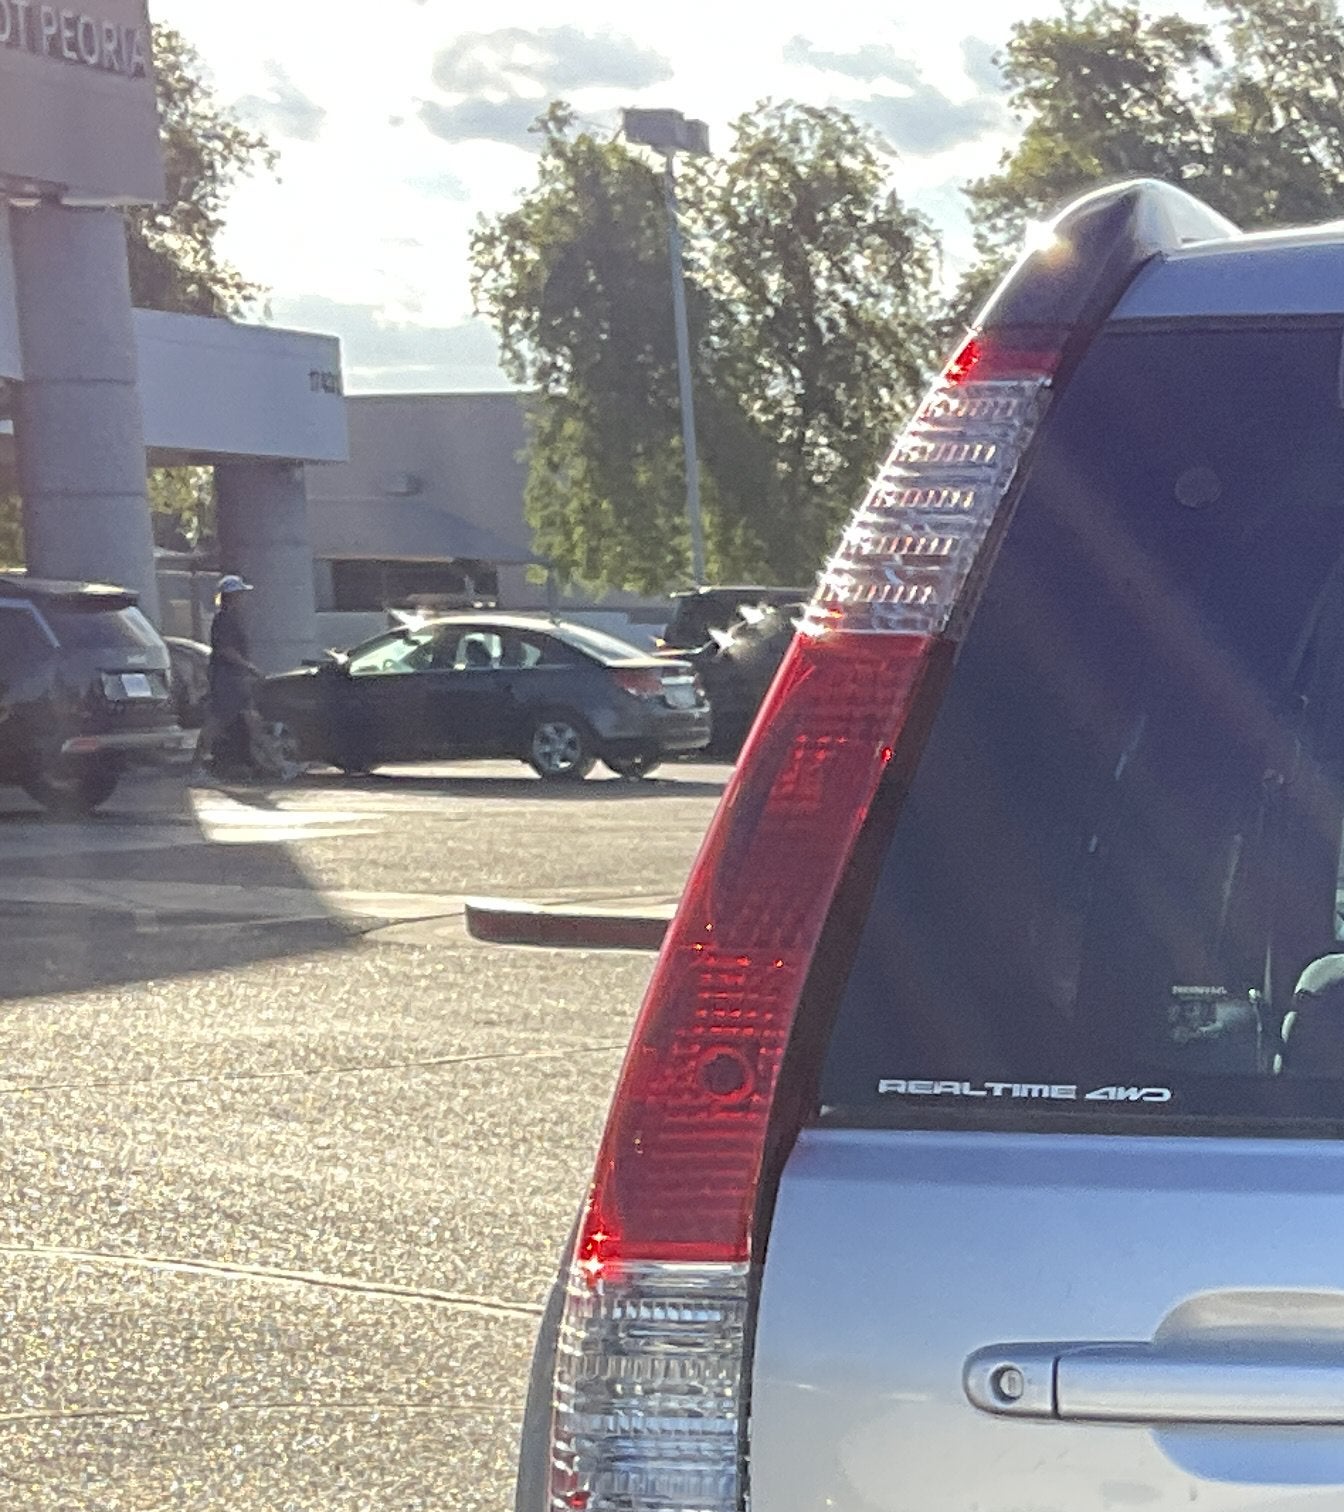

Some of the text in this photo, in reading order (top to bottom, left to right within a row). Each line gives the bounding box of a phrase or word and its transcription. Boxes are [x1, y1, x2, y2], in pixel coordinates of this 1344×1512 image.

[40, 4, 147, 79] PEORIA
[878, 1078, 1173, 1102] REALTIME 4WD
